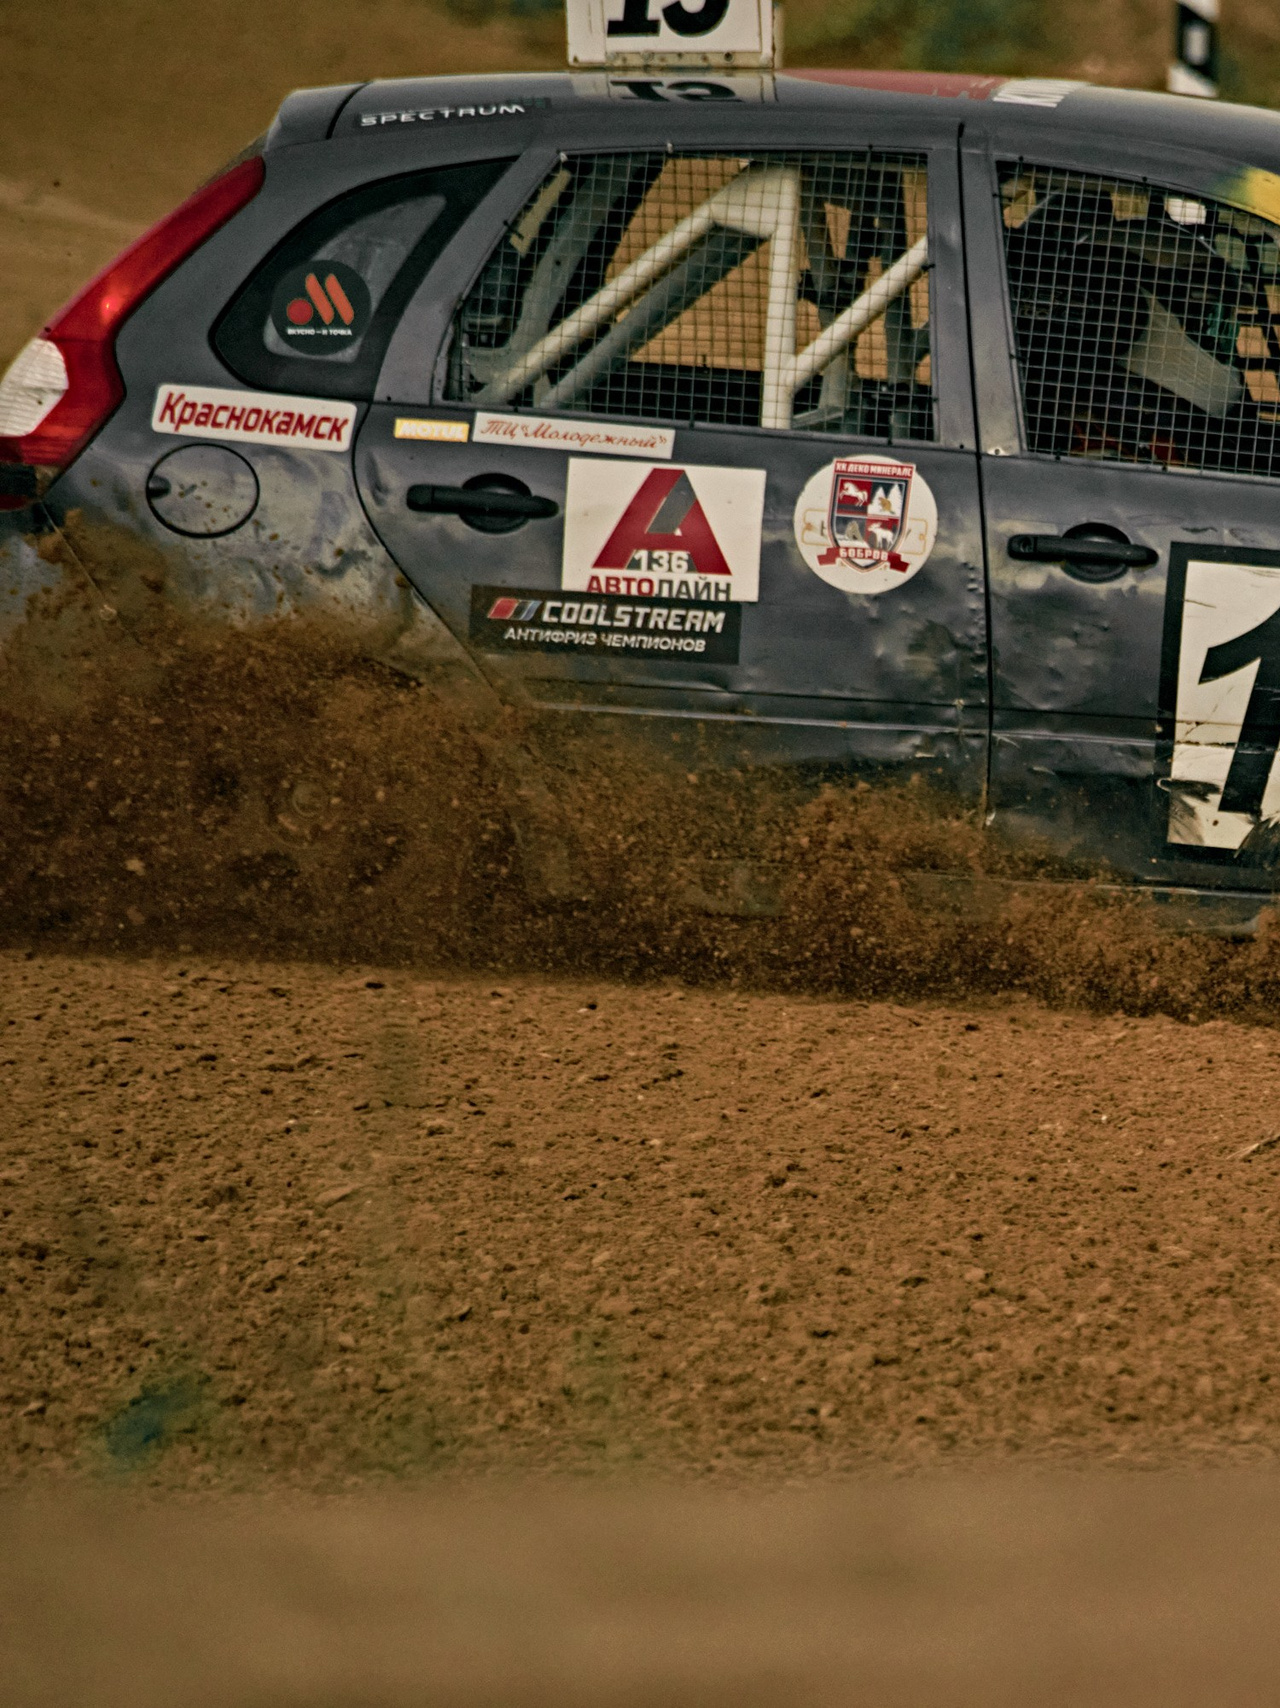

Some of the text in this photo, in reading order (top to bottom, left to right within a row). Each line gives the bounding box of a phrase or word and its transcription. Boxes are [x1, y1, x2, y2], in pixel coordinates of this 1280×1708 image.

[360, 104, 526, 127] SPECTRUM
[286, 328, 315, 336] ВКУСНО
[329, 328, 353, 336] ТОЧКА
[158, 391, 349, 442] Краснокамск
[399, 419, 465, 439] MOTUL
[848, 463, 869, 473] ДЕКО
[870, 465, 912, 477] МИНЕРАЛС
[633, 550, 690, 573] 136
[839, 548, 889, 560] БОБРОВ
[586, 575, 732, 601] АВТОЛАЙН
[541, 601, 726, 633] COOLSTREAM
[503, 627, 707, 652] АНТИФРИЗ ЧЕМПИОНОВ
